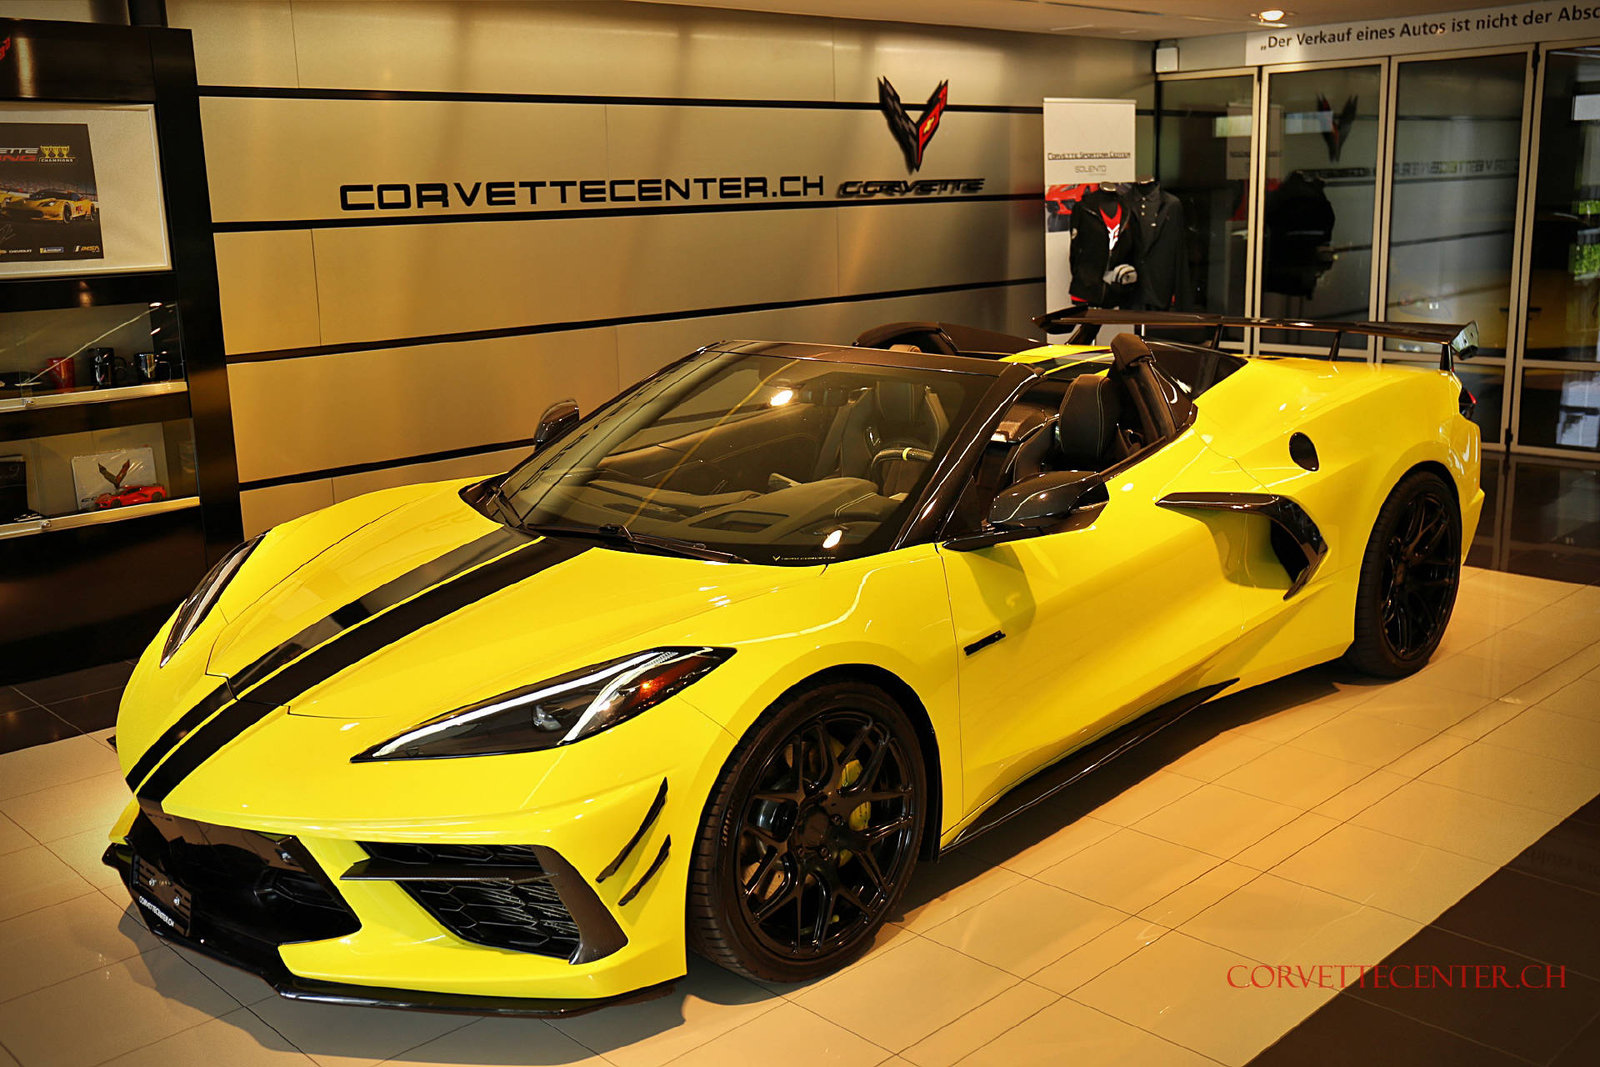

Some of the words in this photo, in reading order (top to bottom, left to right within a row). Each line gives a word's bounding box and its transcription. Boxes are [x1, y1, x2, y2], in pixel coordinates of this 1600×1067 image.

[1296, 28, 1352, 46] Verkauf
[1356, 27, 1396, 41] eines
[1399, 21, 1446, 38] Autos
[1451, 18, 1471, 33] ist
[1476, 13, 1518, 30] nicht
[1522, 10, 1552, 26] der
[339, 175, 824, 211] CORVETTECENTER.CH
[836, 178, 985, 199] CORVETTE
